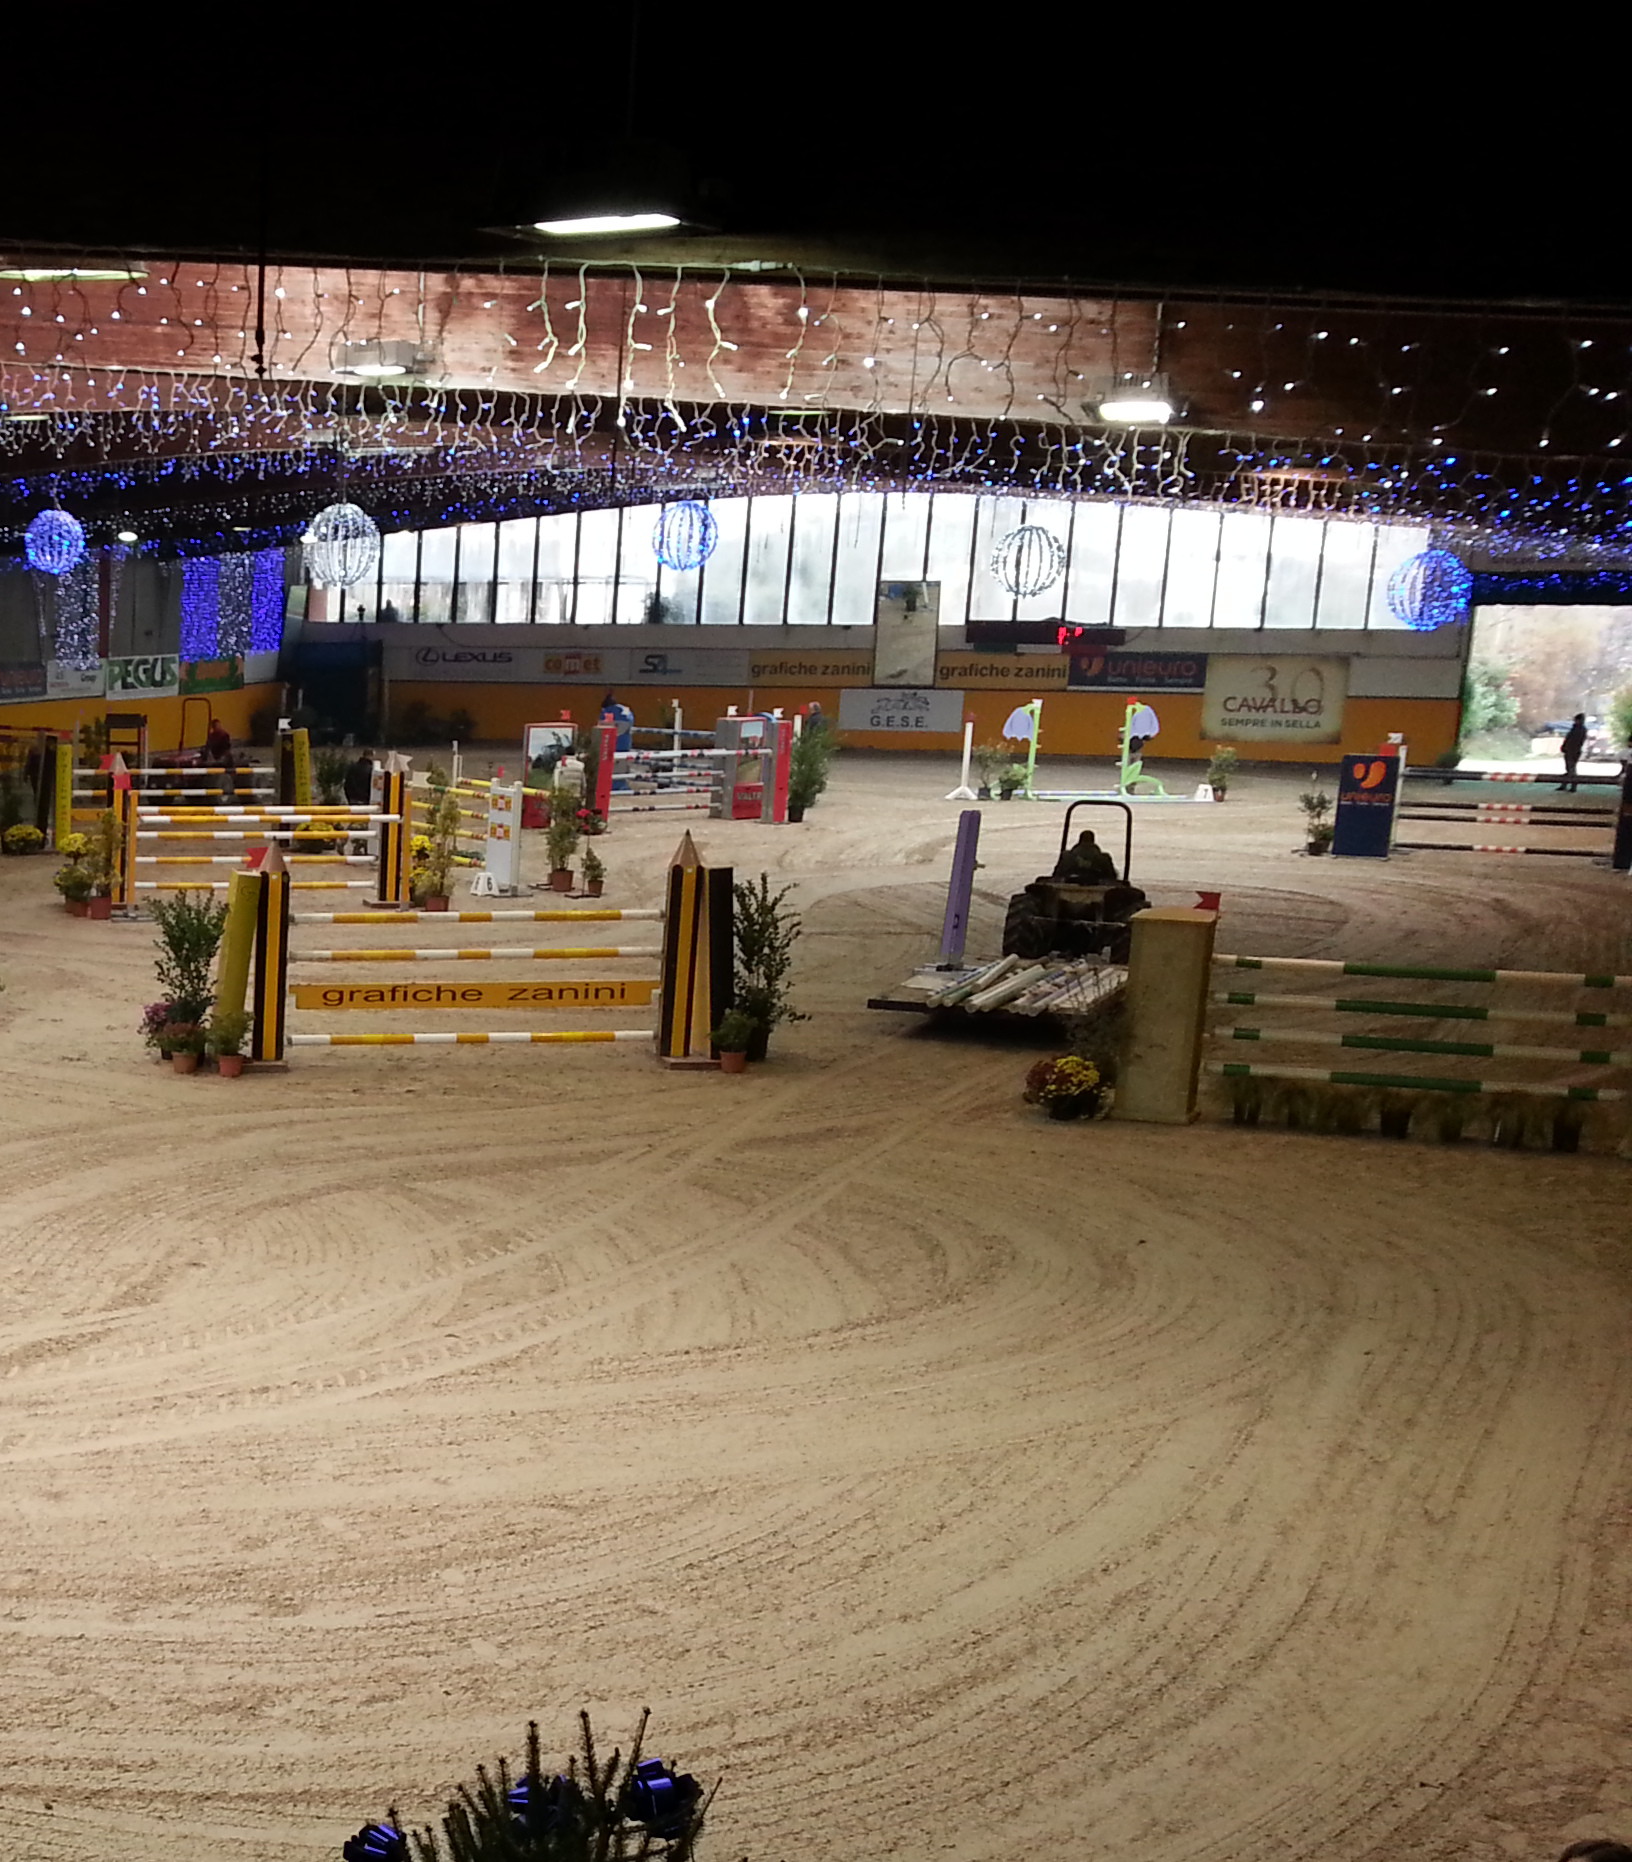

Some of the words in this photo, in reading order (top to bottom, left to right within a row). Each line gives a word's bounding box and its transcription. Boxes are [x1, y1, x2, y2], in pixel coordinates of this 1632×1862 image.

[442, 652, 513, 663] LEXUS
[108, 656, 179, 691] PEGUS
[751, 661, 818, 679] grafiche
[821, 662, 871, 676] zanini
[939, 664, 1010, 680] grafiche
[1013, 665, 1067, 679] zanini
[1108, 659, 1197, 677] unieuro
[1223, 696, 1323, 716] CAVALLO
[870, 715, 929, 729] G.E.S.E.
[1221, 718, 1267, 728] SEMPRE
[1270, 719, 1283, 729] IN
[1284, 719, 1322, 730] SELLA
[322, 984, 484, 1008] grafiche
[507, 982, 627, 1002] zanini
